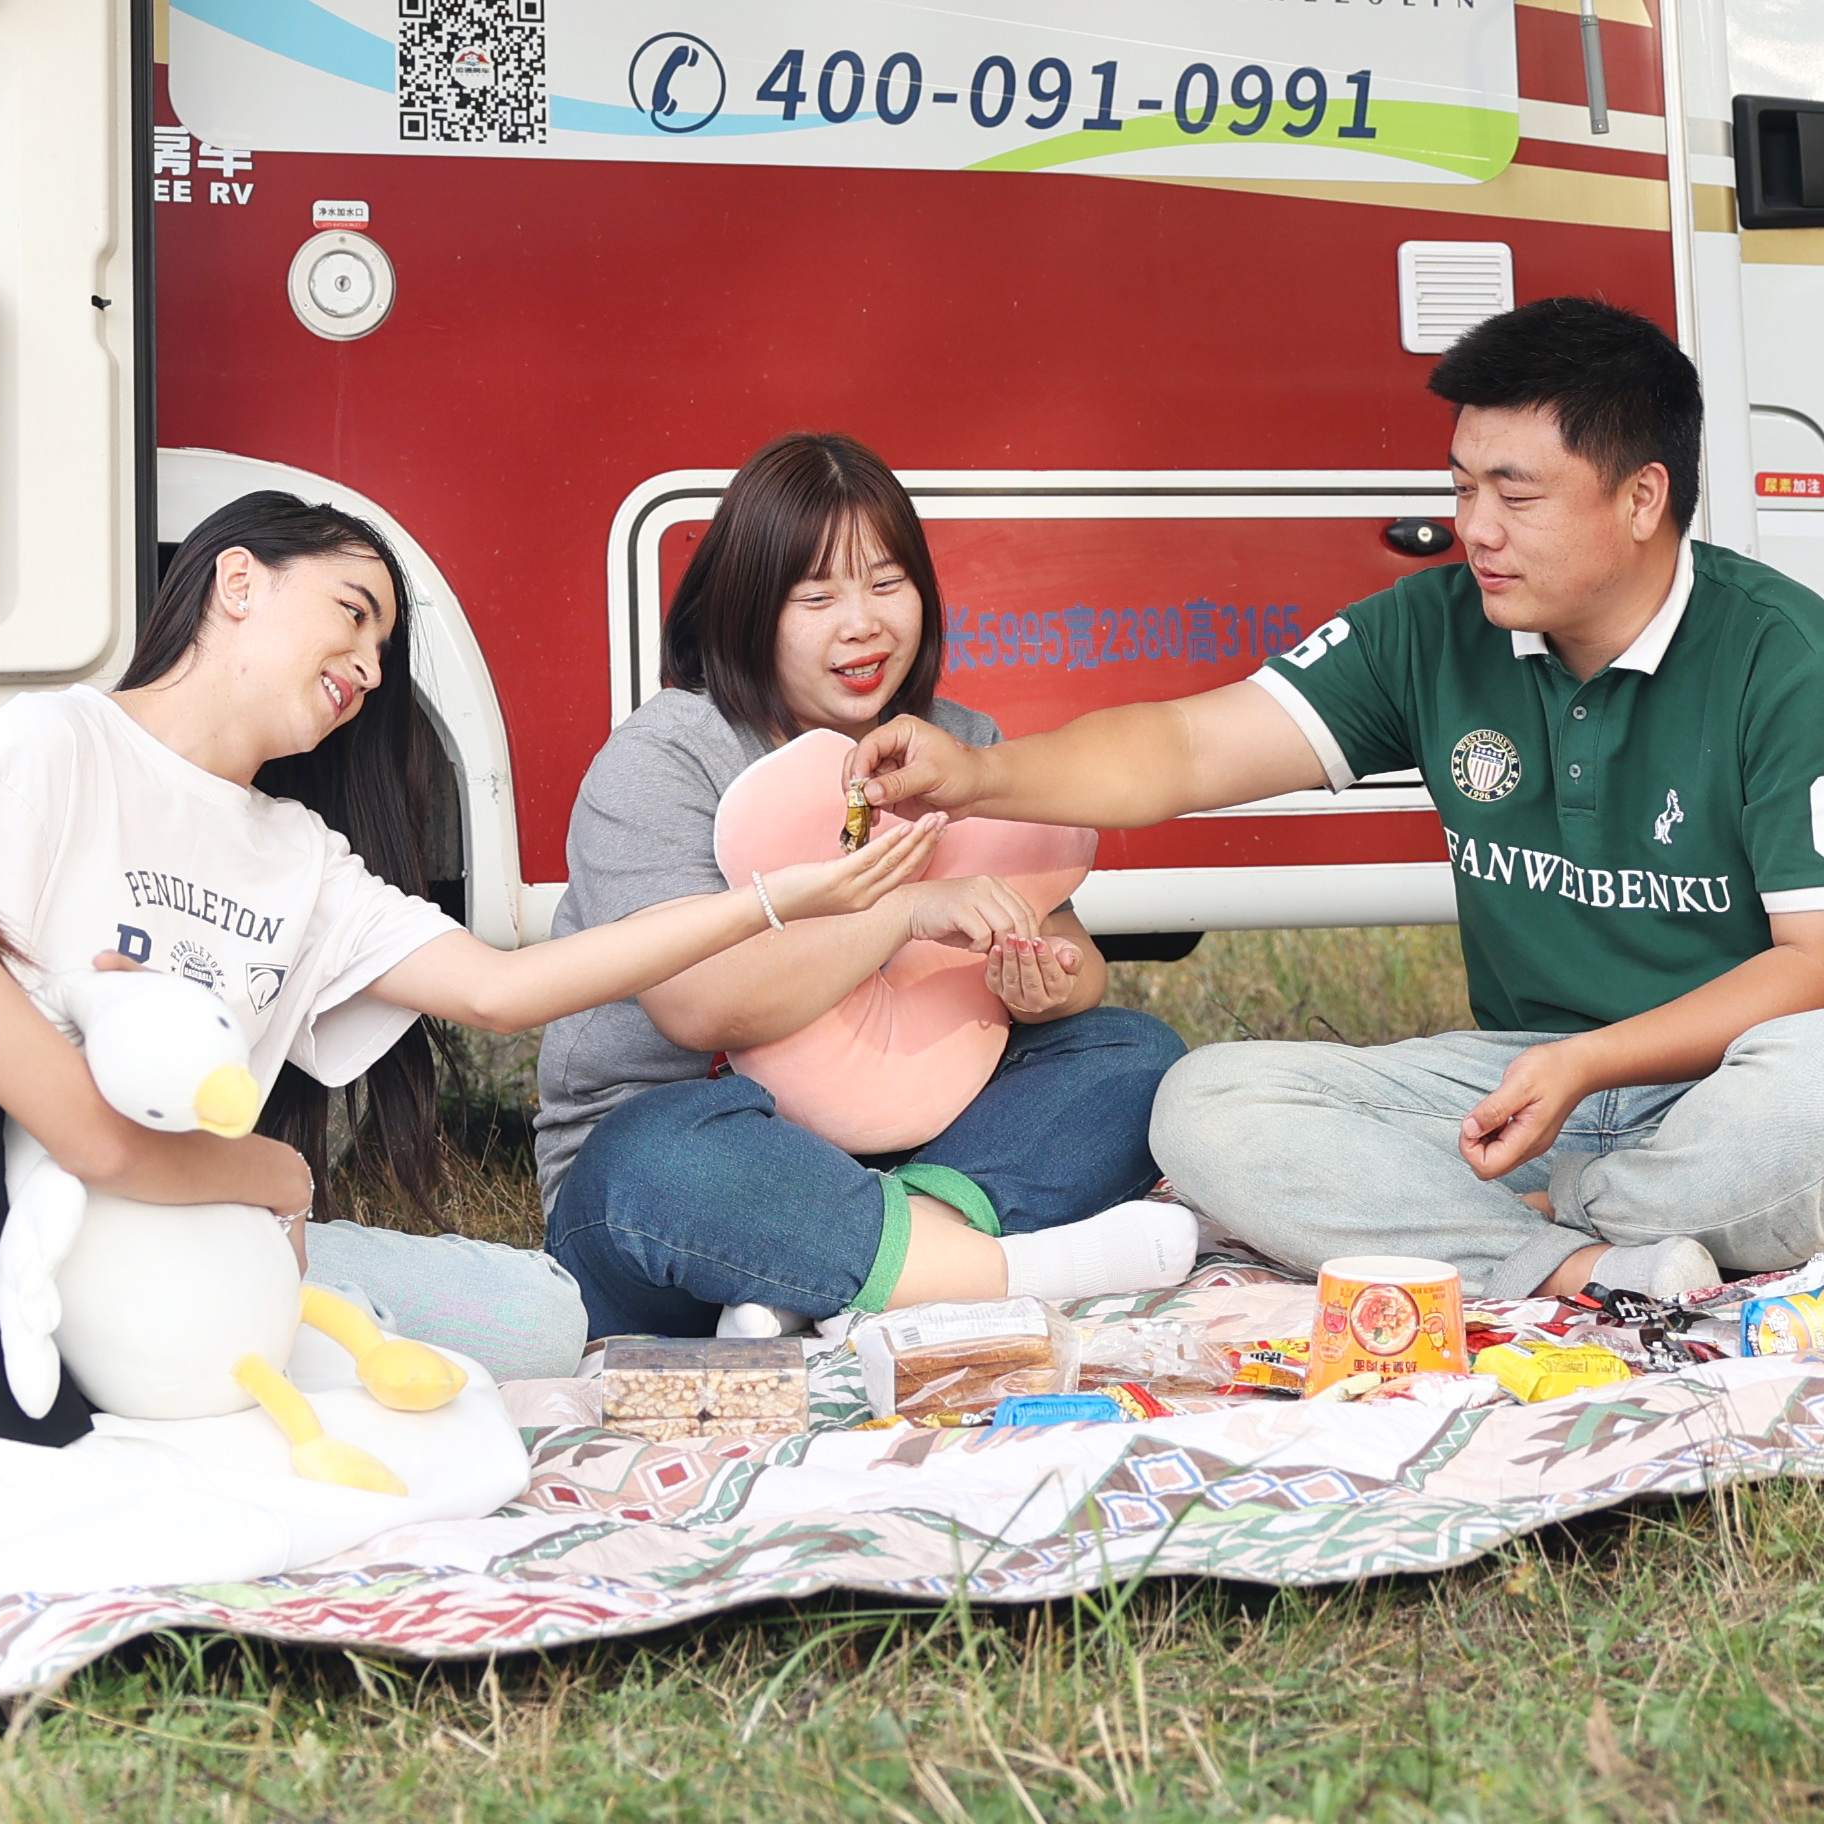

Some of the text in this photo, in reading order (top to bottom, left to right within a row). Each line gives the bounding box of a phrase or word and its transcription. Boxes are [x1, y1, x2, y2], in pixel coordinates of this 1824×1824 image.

[755, 49, 1378, 139] 400-091-0991
[210, 182, 254, 205] RV
[1764, 477, 1821, 494] 尿素加注
[1456, 731, 1518, 764] WESTMINSTER
[1467, 788, 1491, 800] 1996
[1443, 826, 1731, 913] FANWEIBENKU
[125, 870, 285, 945] PENDLETON
